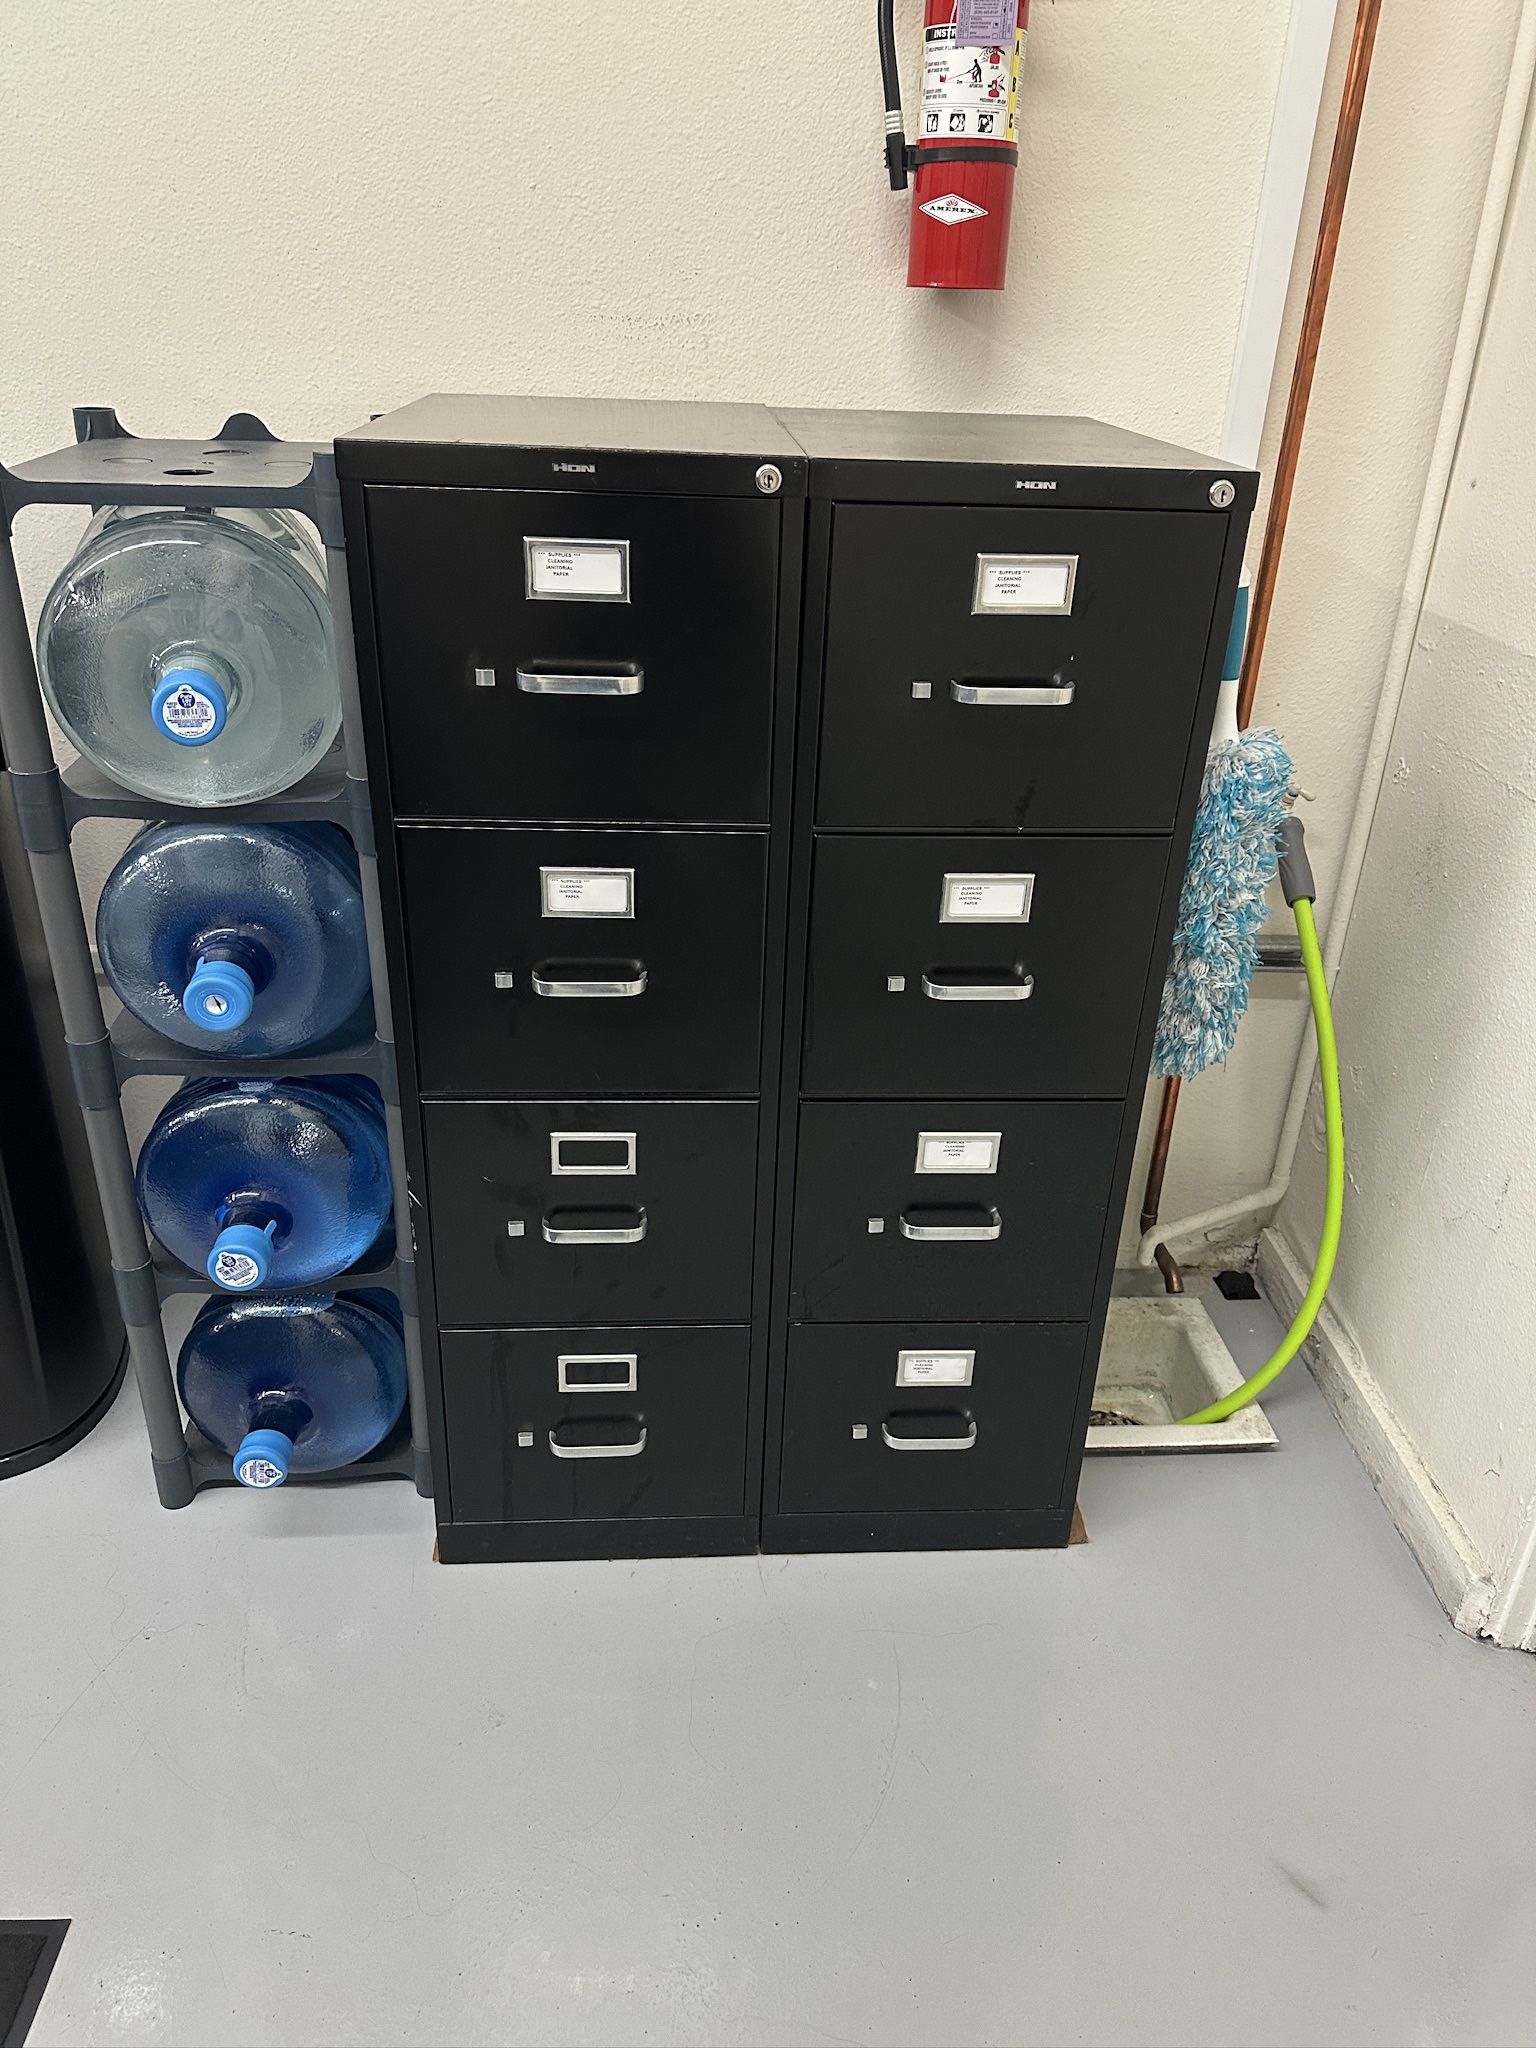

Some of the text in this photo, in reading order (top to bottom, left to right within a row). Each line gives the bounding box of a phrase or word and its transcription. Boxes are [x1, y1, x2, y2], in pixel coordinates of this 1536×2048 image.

[933, 28, 957, 39] INSTR
[930, 205, 974, 214] AMEREX
[552, 462, 596, 473] HON
[1015, 480, 1057, 490] HON
